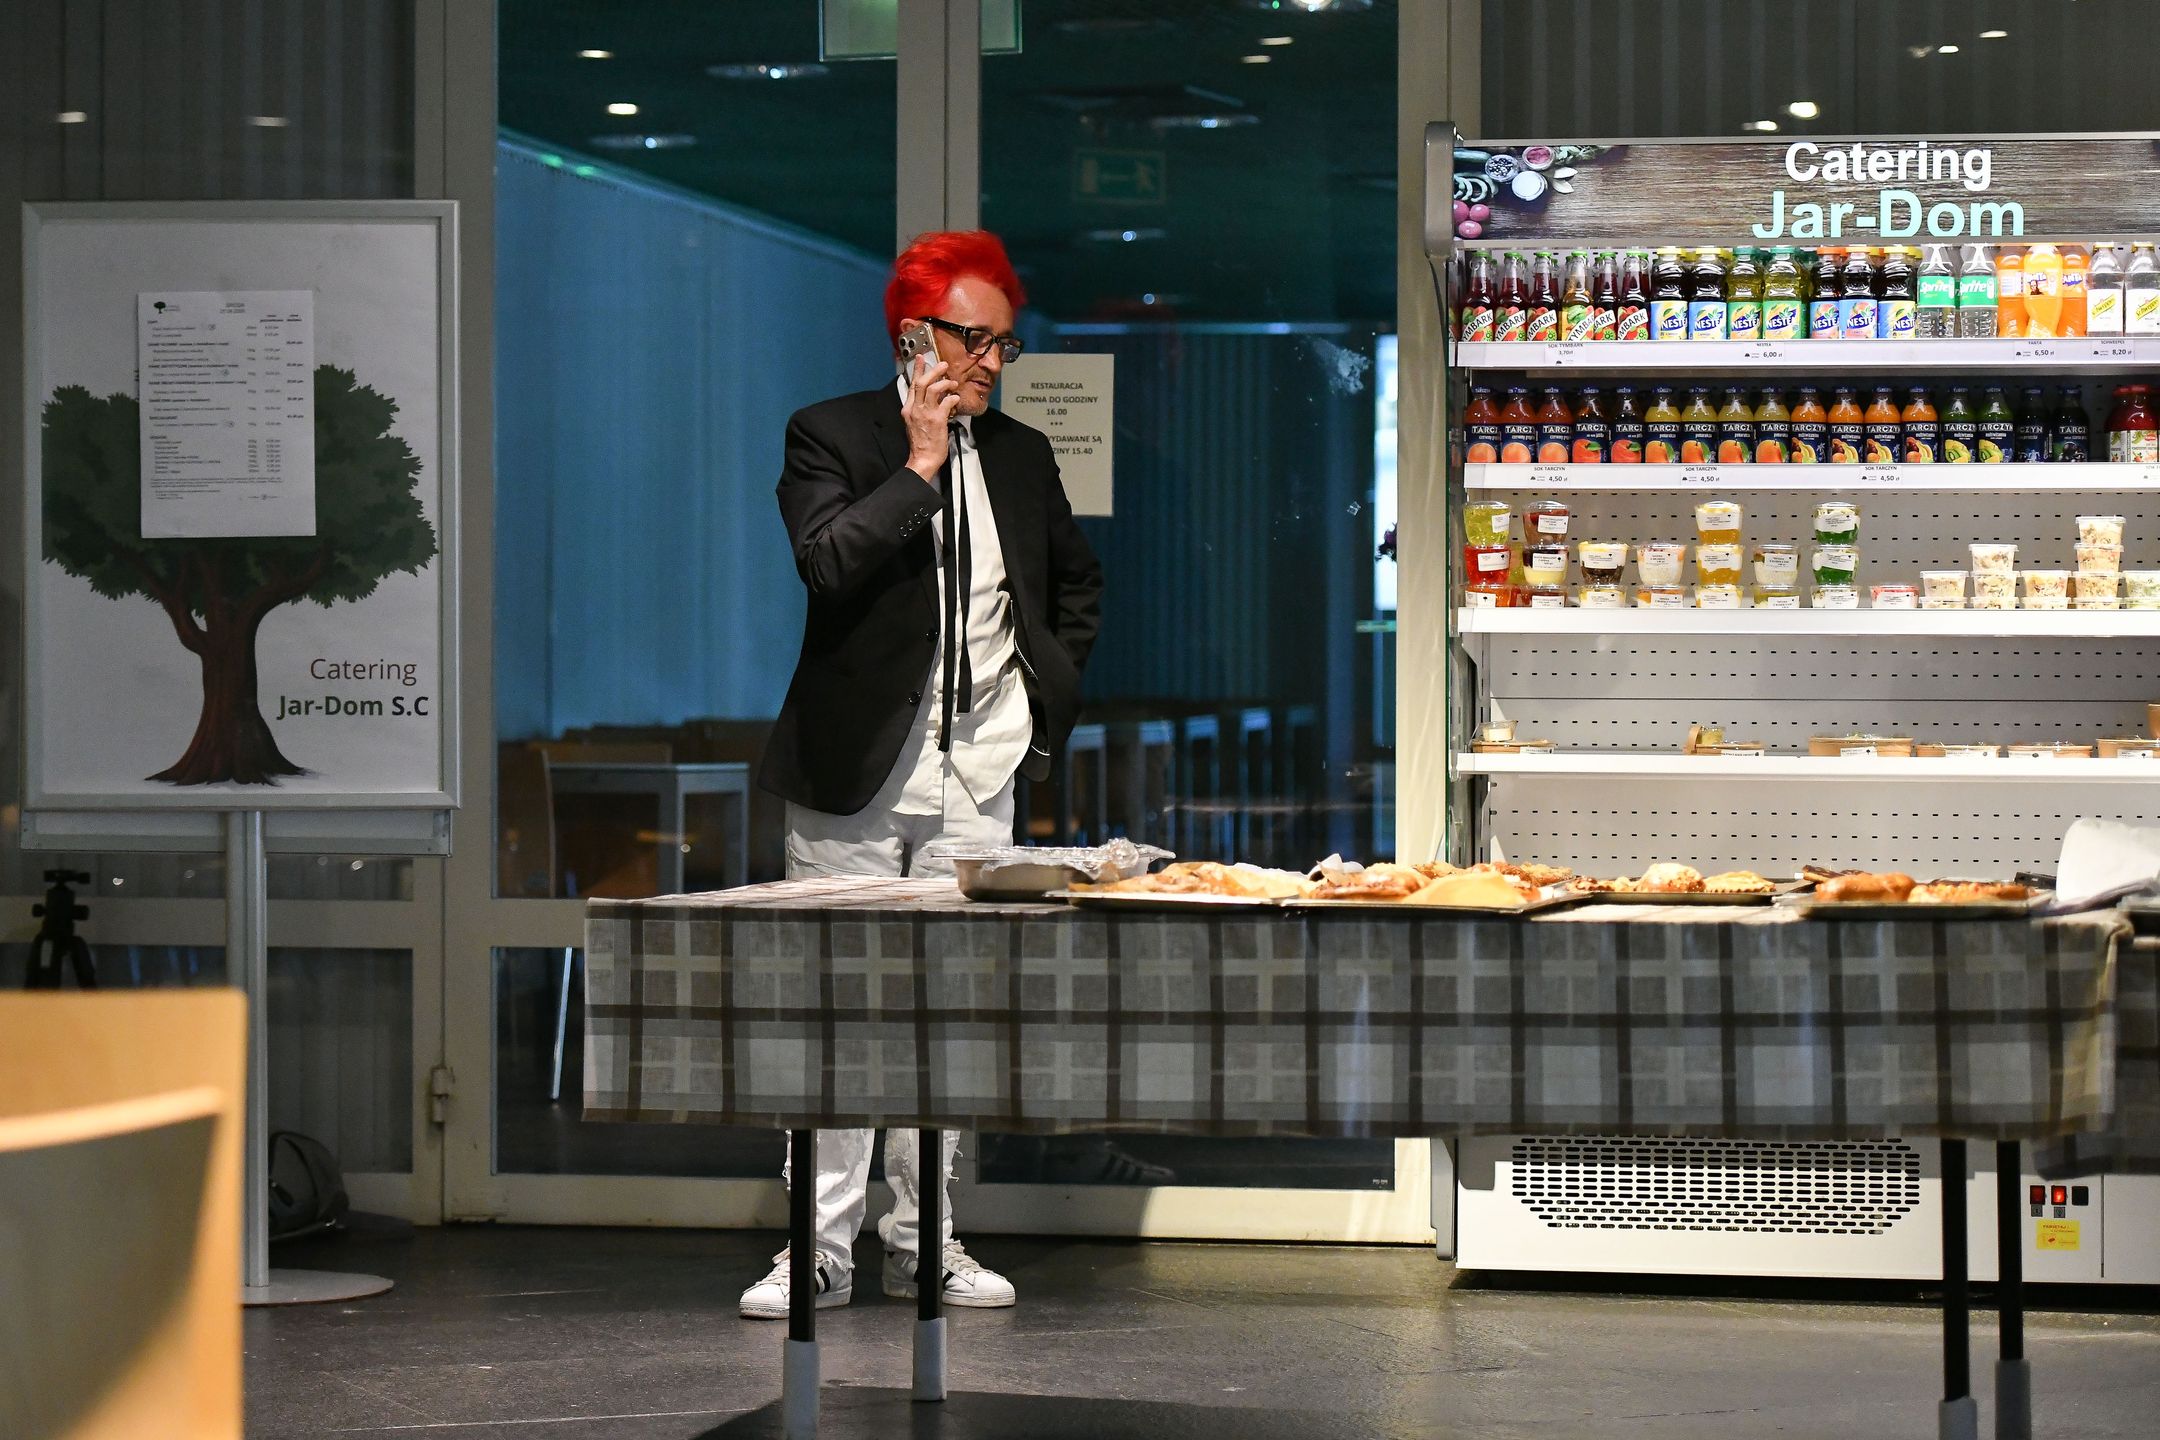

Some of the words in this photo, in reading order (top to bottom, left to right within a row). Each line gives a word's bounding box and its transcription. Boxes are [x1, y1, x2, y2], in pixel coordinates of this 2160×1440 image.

[1785, 141, 1992, 192] Catering
[1752, 189, 2025, 238] Jar-Dom
[2062, 273, 2083, 283] ANTA
[1031, 382, 1083, 390] RESTAURACJA
[1047, 408, 1067, 416] 16.00
[1092, 435, 1102, 444] SĄ
[1053, 447, 1070, 455] ZINY
[1072, 447, 1093, 455] 15.40
[310, 658, 417, 687] Catering
[276, 695, 383, 721] Jar-Dom
[391, 695, 429, 716] S.C
